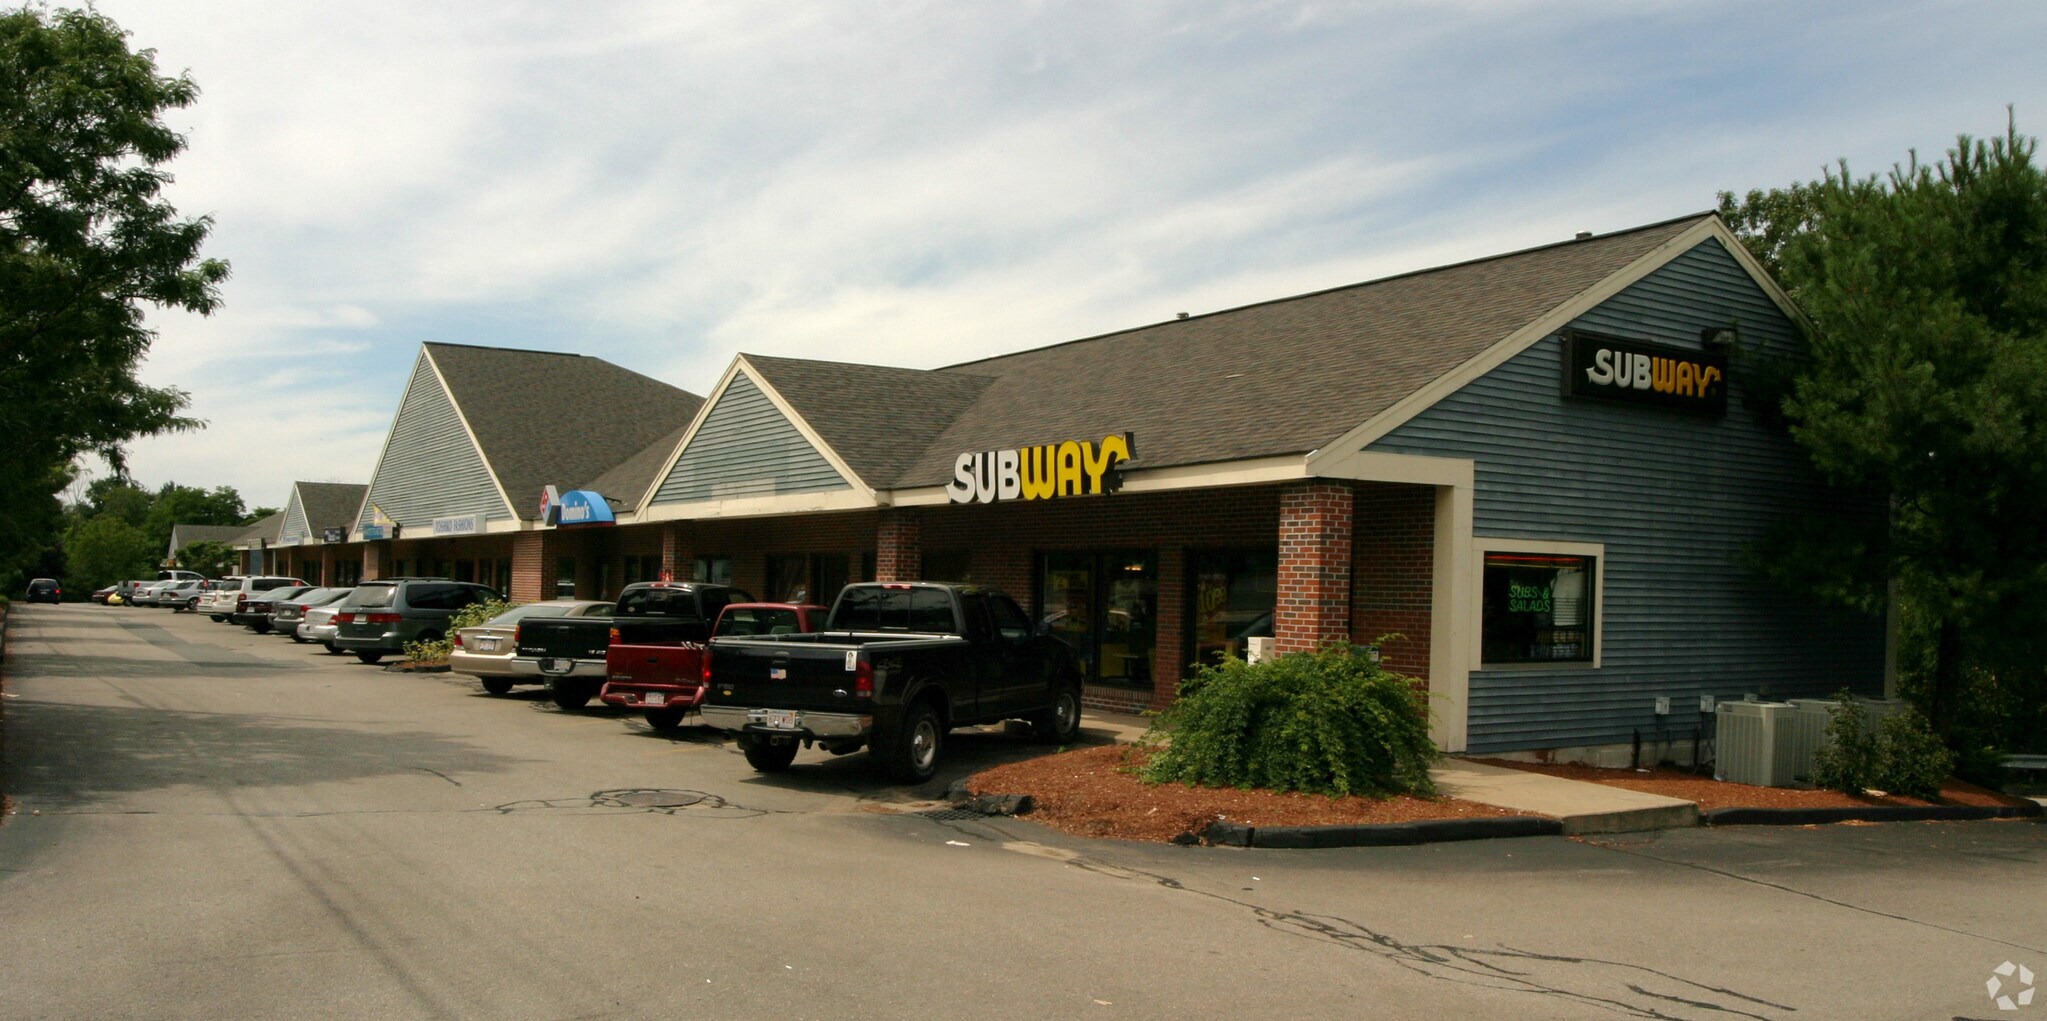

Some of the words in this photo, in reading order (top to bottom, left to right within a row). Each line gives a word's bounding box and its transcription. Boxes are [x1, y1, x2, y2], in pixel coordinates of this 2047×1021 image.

[1586, 349, 1721, 398] SUBWAY
[945, 434, 1131, 504] SUBWAY
[561, 501, 590, 521] Domino's
[1509, 585, 1538, 599] SUBS
[1542, 586, 1550, 600] &
[1509, 599, 1551, 612] SALADS
